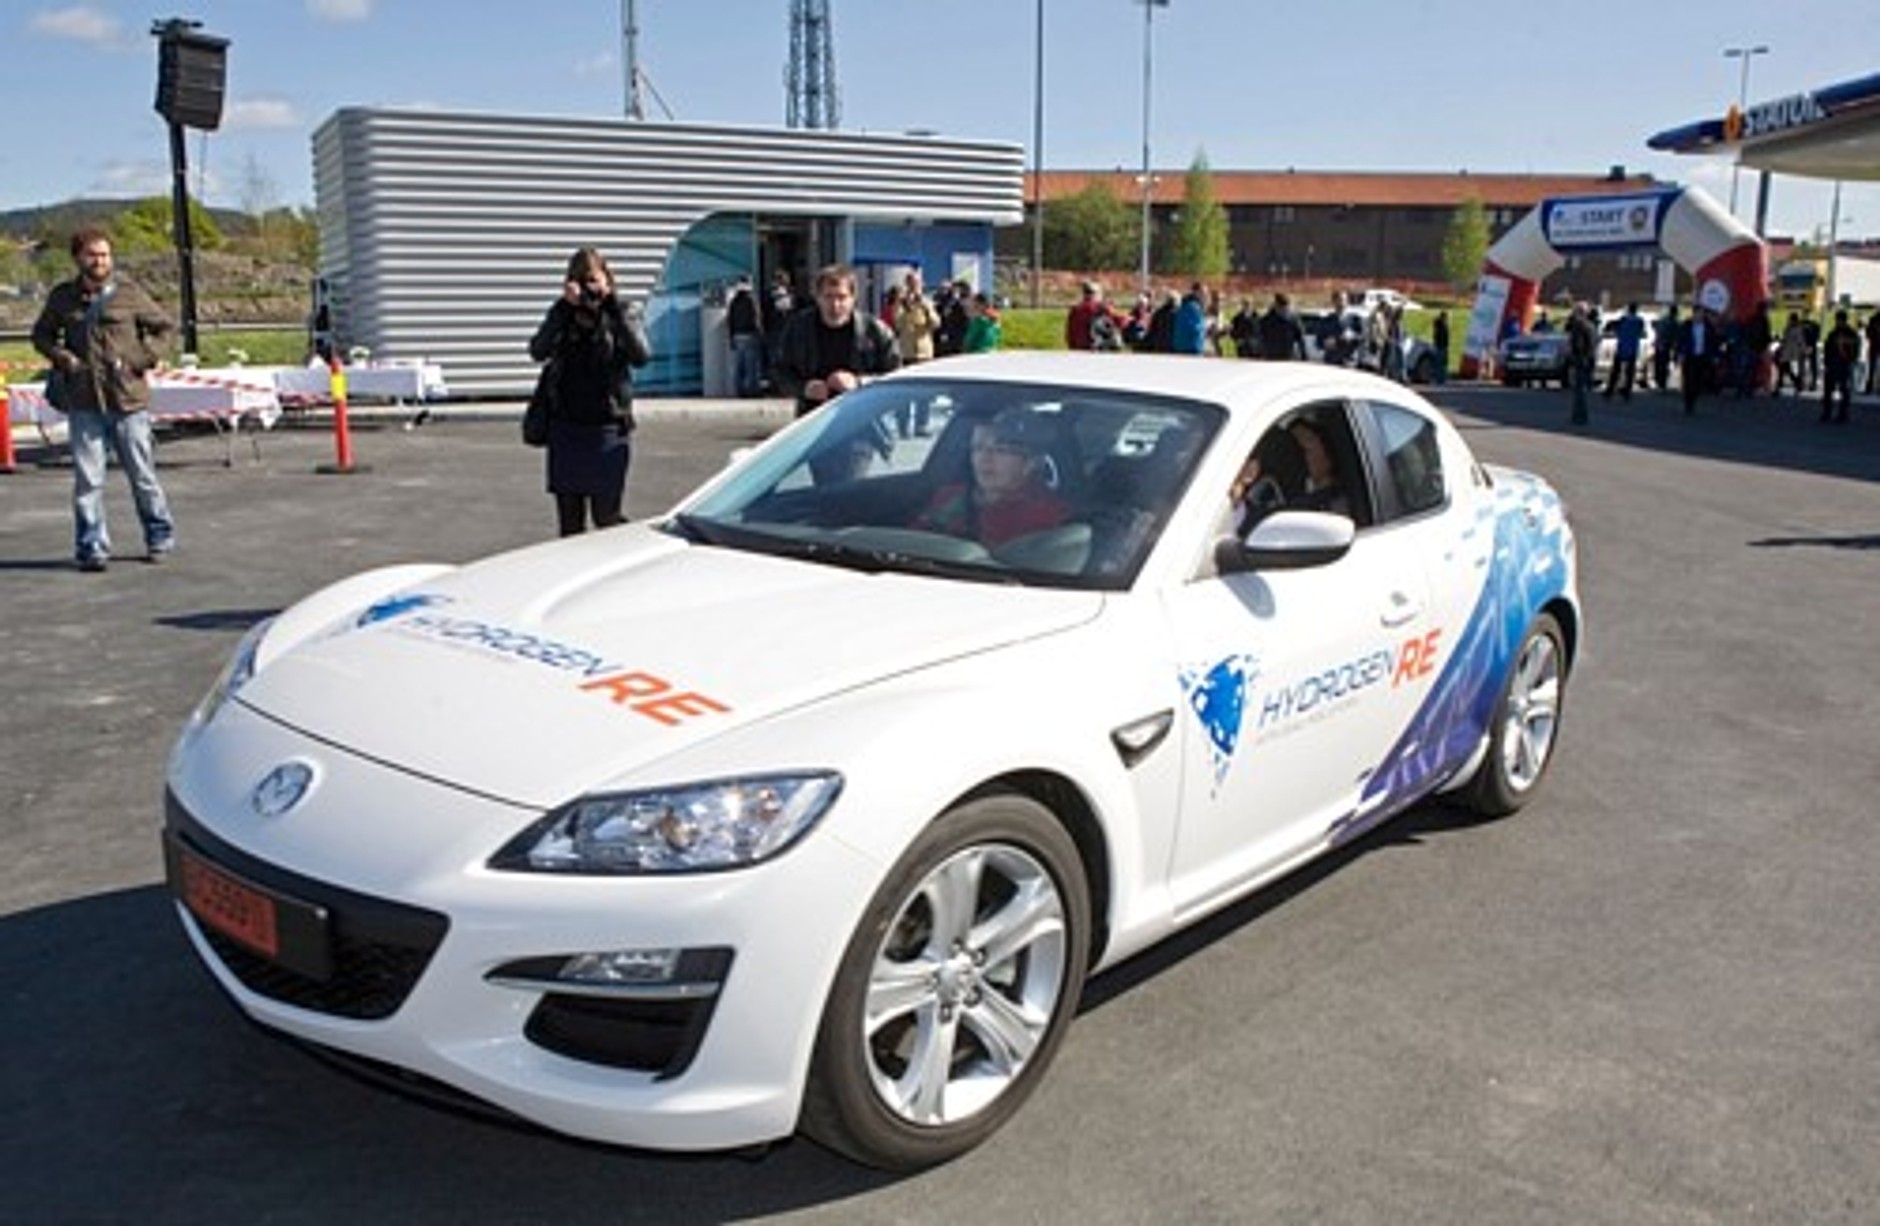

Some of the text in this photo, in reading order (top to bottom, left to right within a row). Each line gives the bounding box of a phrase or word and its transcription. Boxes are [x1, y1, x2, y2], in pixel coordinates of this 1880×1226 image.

[1581, 206, 1625, 226] START
[408, 615, 623, 676] HYDROGEN
[577, 670, 733, 727] RE
[1257, 649, 1393, 728] HYDROGEN
[1391, 627, 1442, 689] RE
